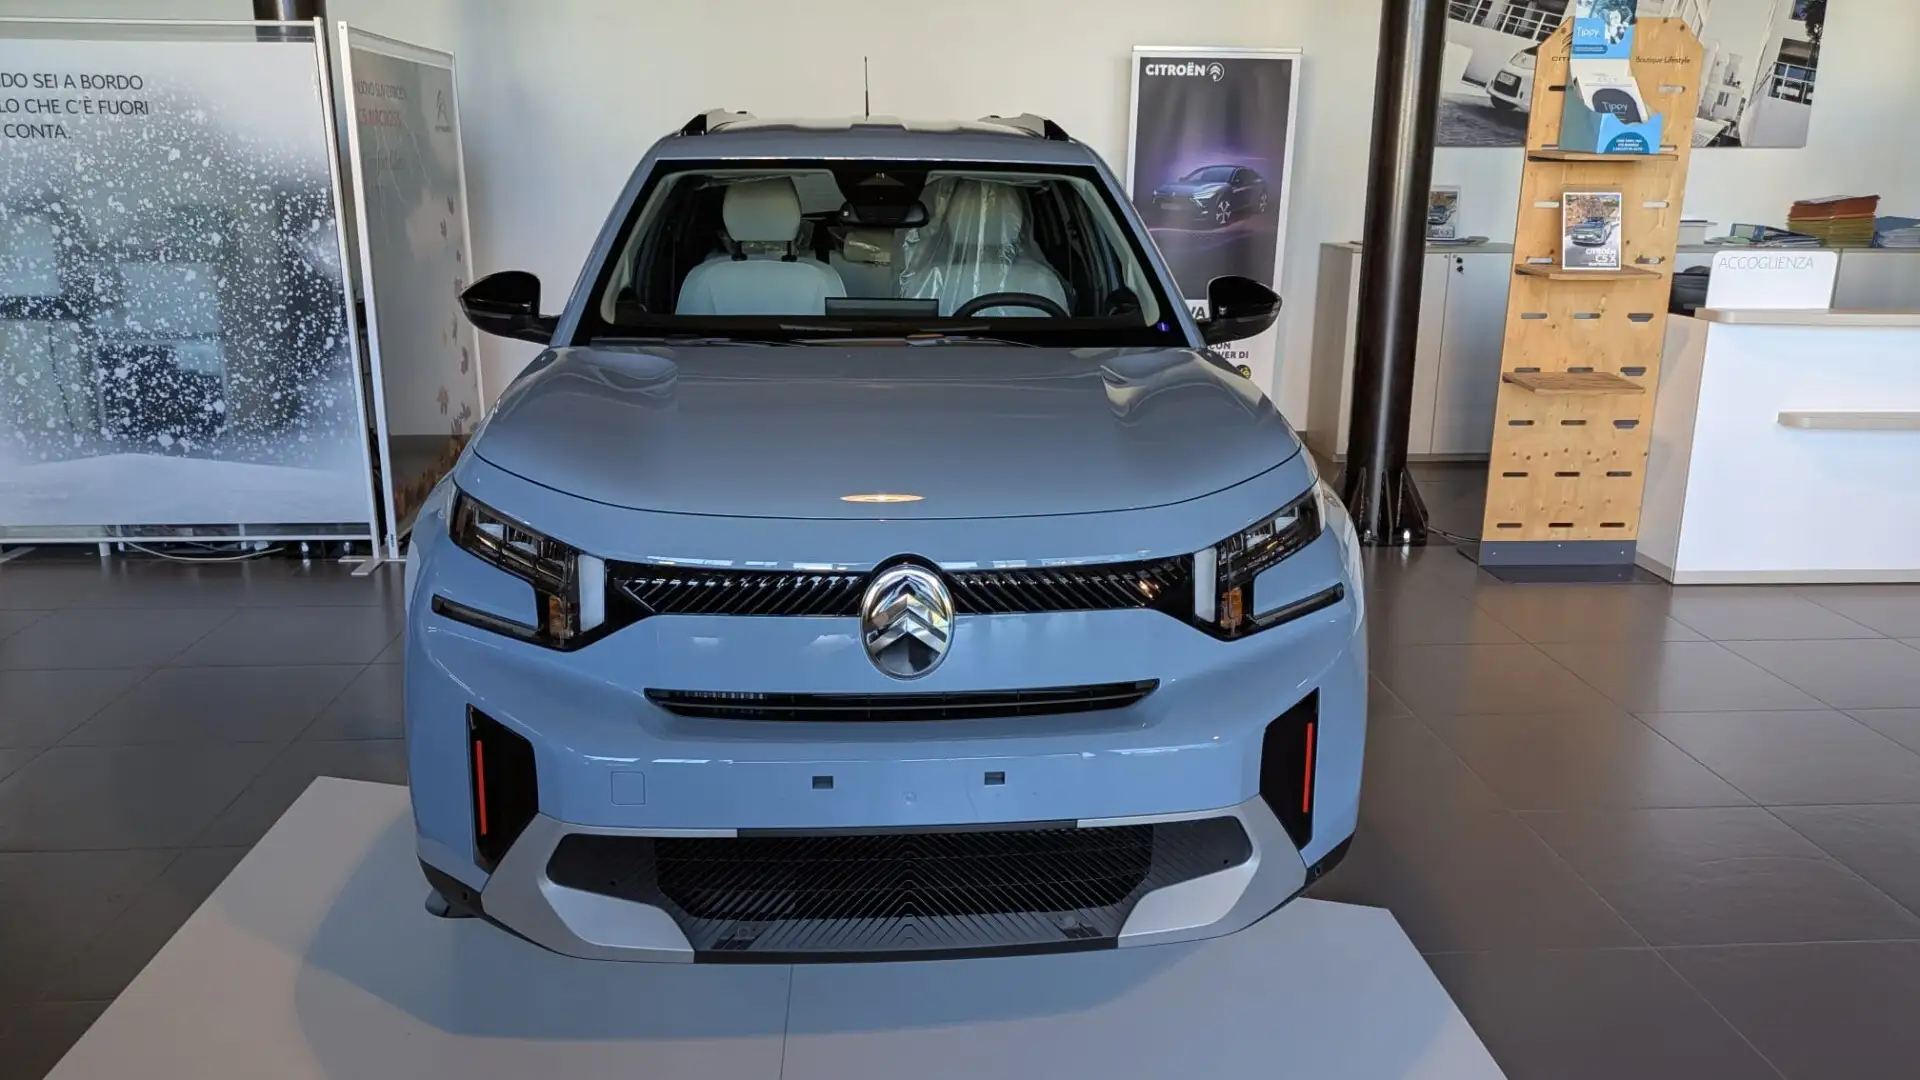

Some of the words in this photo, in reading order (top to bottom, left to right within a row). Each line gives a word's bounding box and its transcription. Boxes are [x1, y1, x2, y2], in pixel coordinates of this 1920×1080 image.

[1664, 55, 1691, 65] Lifestyle
[1145, 62, 1206, 76] CITROËN
[33, 73, 58, 88] SEI
[64, 74, 76, 89] A
[80, 74, 143, 90] BORDO
[25, 99, 62, 114] CHE
[98, 100, 149, 115] FUORI
[1601, 101, 1628, 111] Tippy
[4, 123, 72, 140] CONTA.
[1719, 256, 1814, 270] ACCOGLIENZA
